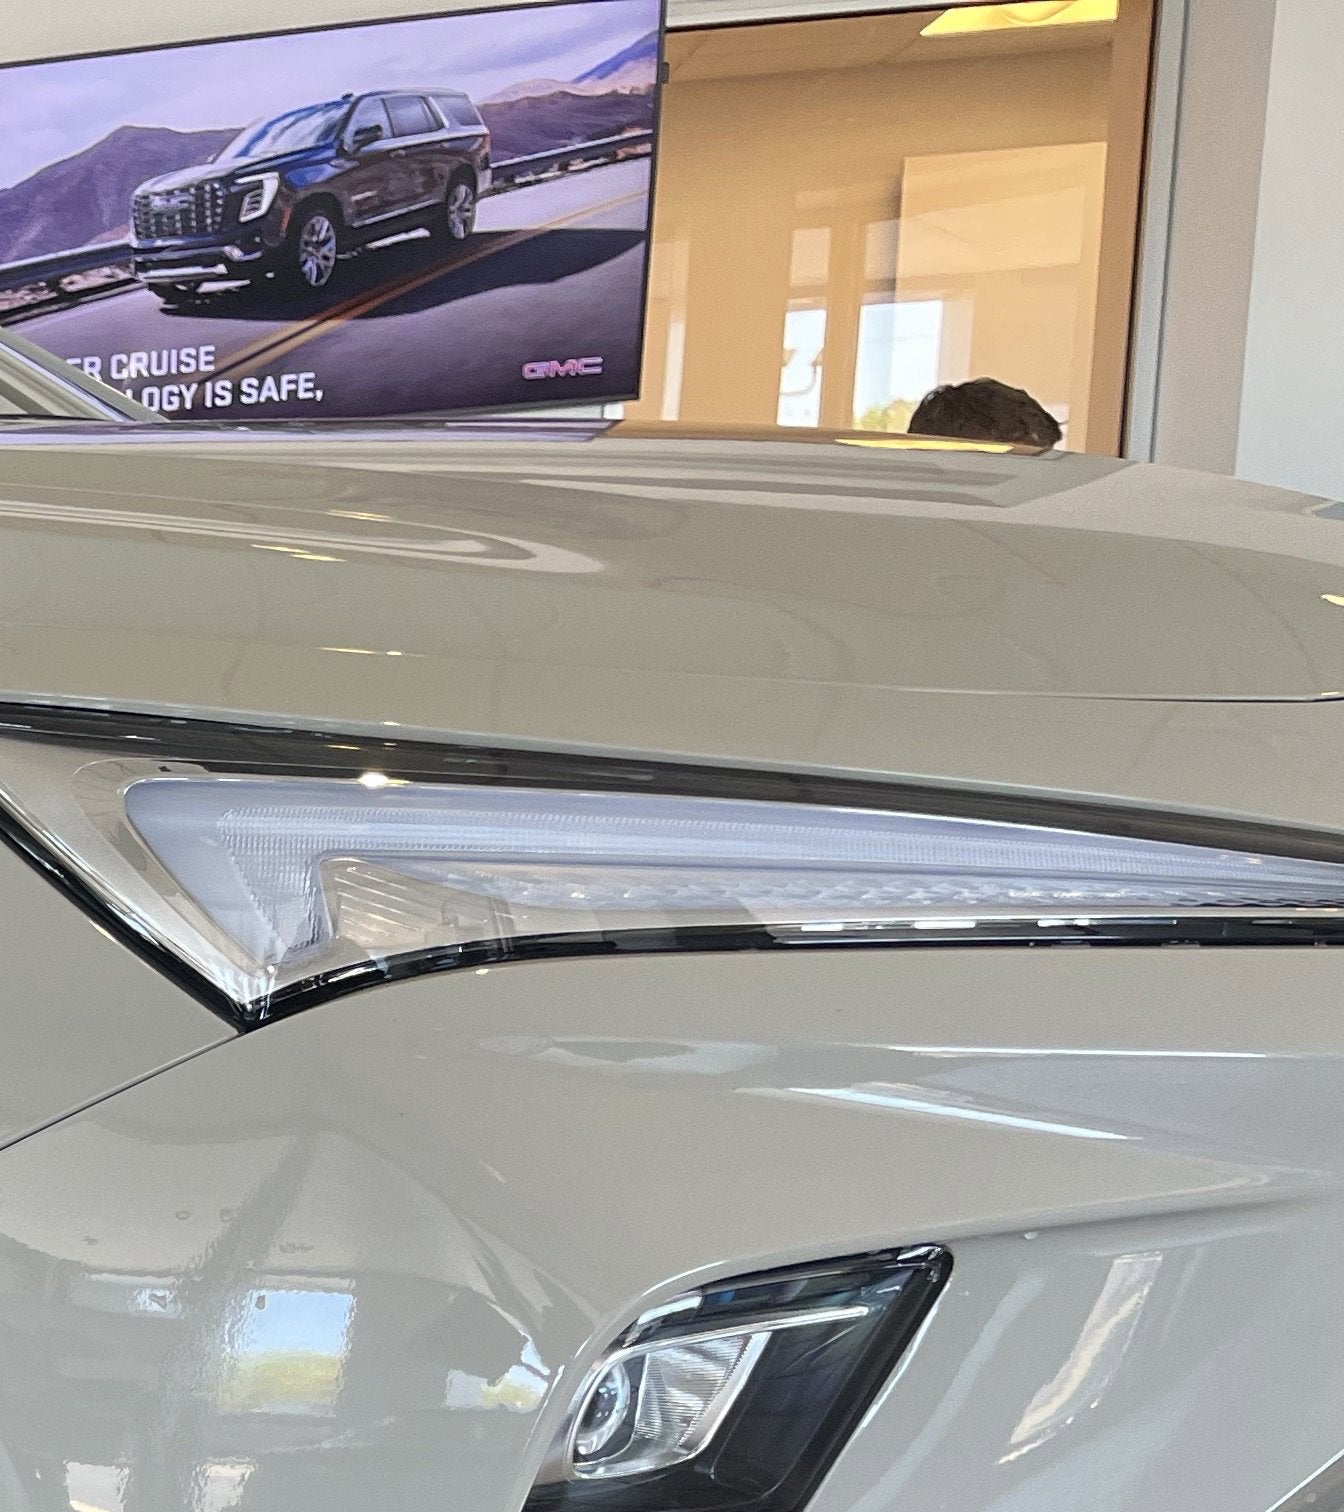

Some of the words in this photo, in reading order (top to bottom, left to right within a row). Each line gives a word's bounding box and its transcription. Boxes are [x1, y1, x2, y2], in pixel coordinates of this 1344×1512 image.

[111, 345, 216, 380] CRUISE
[204, 378, 233, 408] IS
[239, 371, 324, 406] SAFE,
